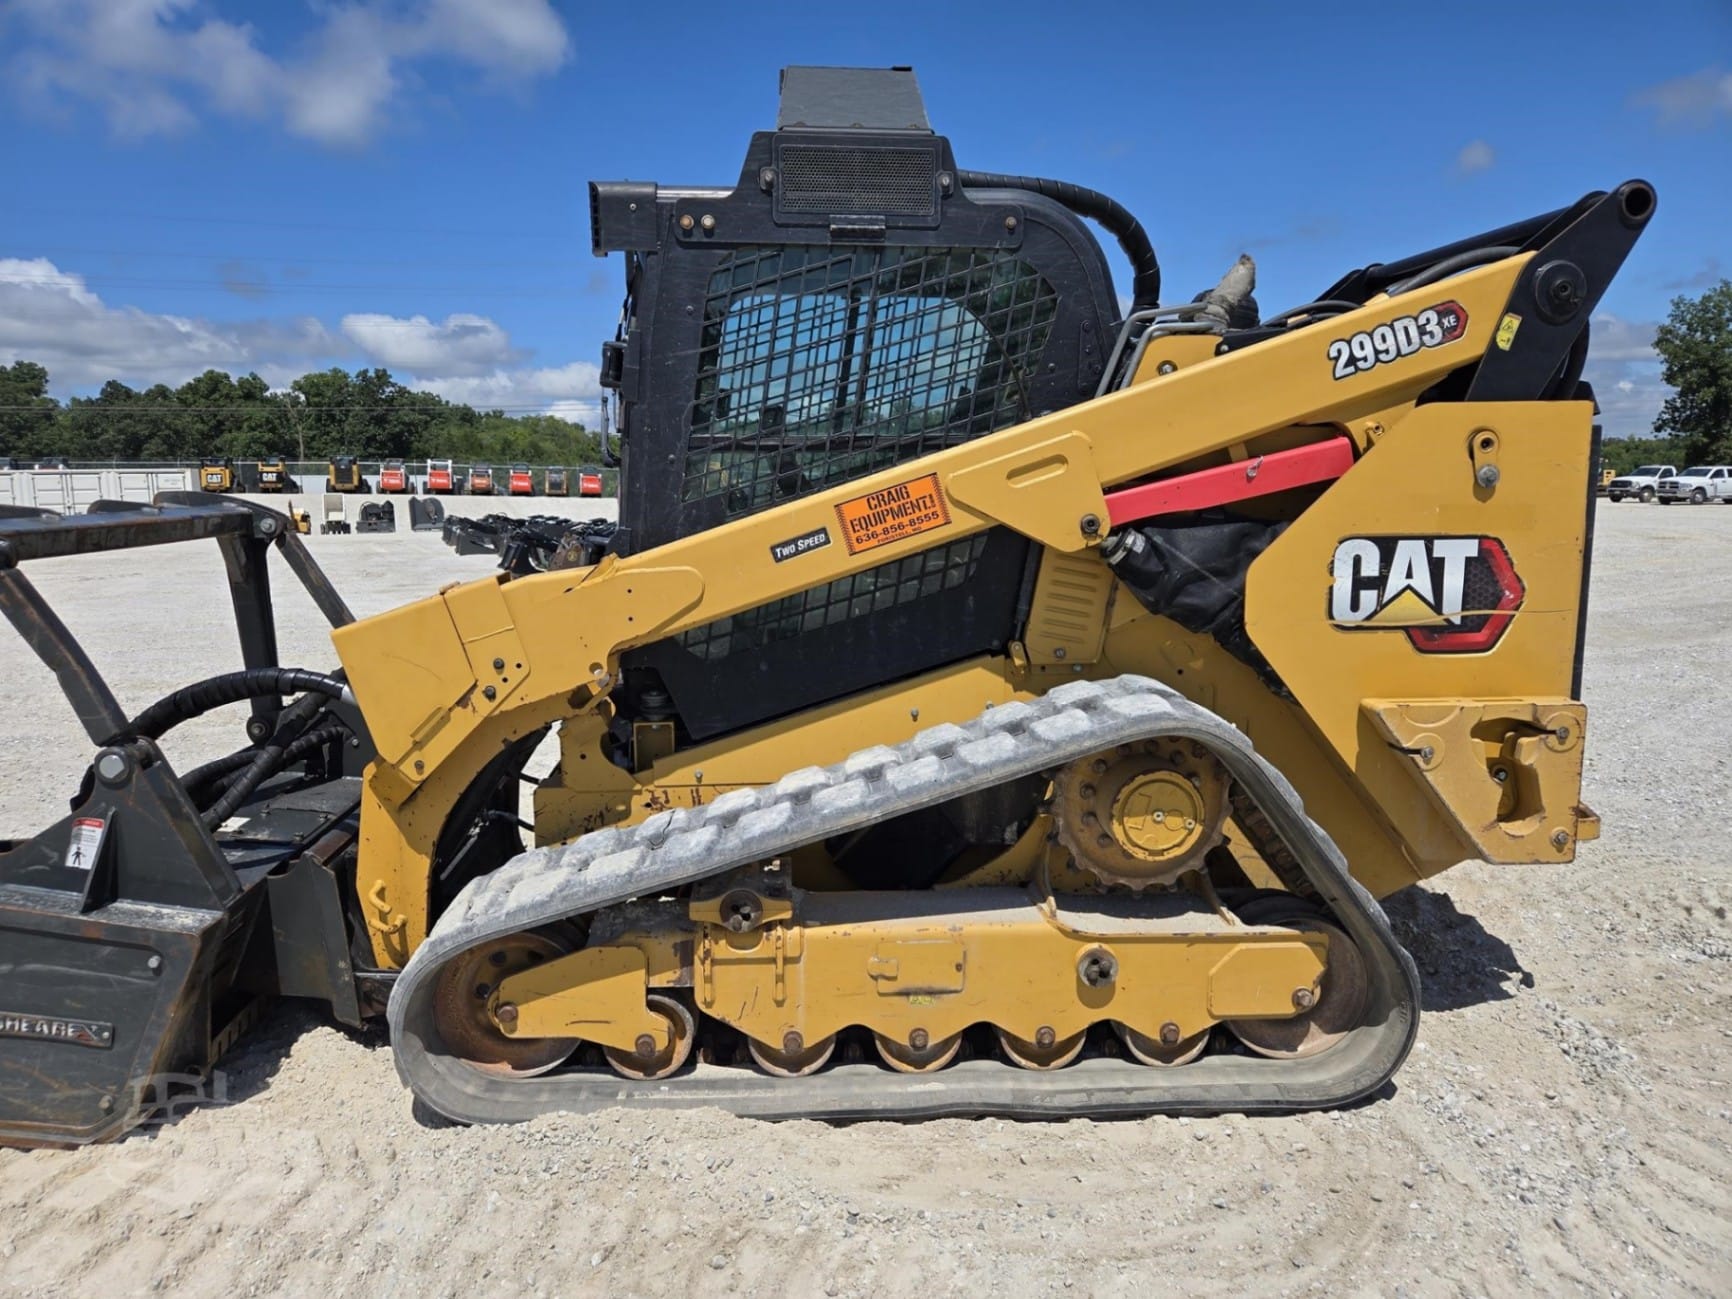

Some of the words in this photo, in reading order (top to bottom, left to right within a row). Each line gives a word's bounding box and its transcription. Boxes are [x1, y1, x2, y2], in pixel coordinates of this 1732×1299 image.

[1328, 309, 1443, 379] 299D3
[1441, 314, 1457, 329] XE
[867, 485, 910, 511] CRAIG
[855, 511, 939, 545] 636-856-8555
[1331, 538, 1480, 626] CAT
